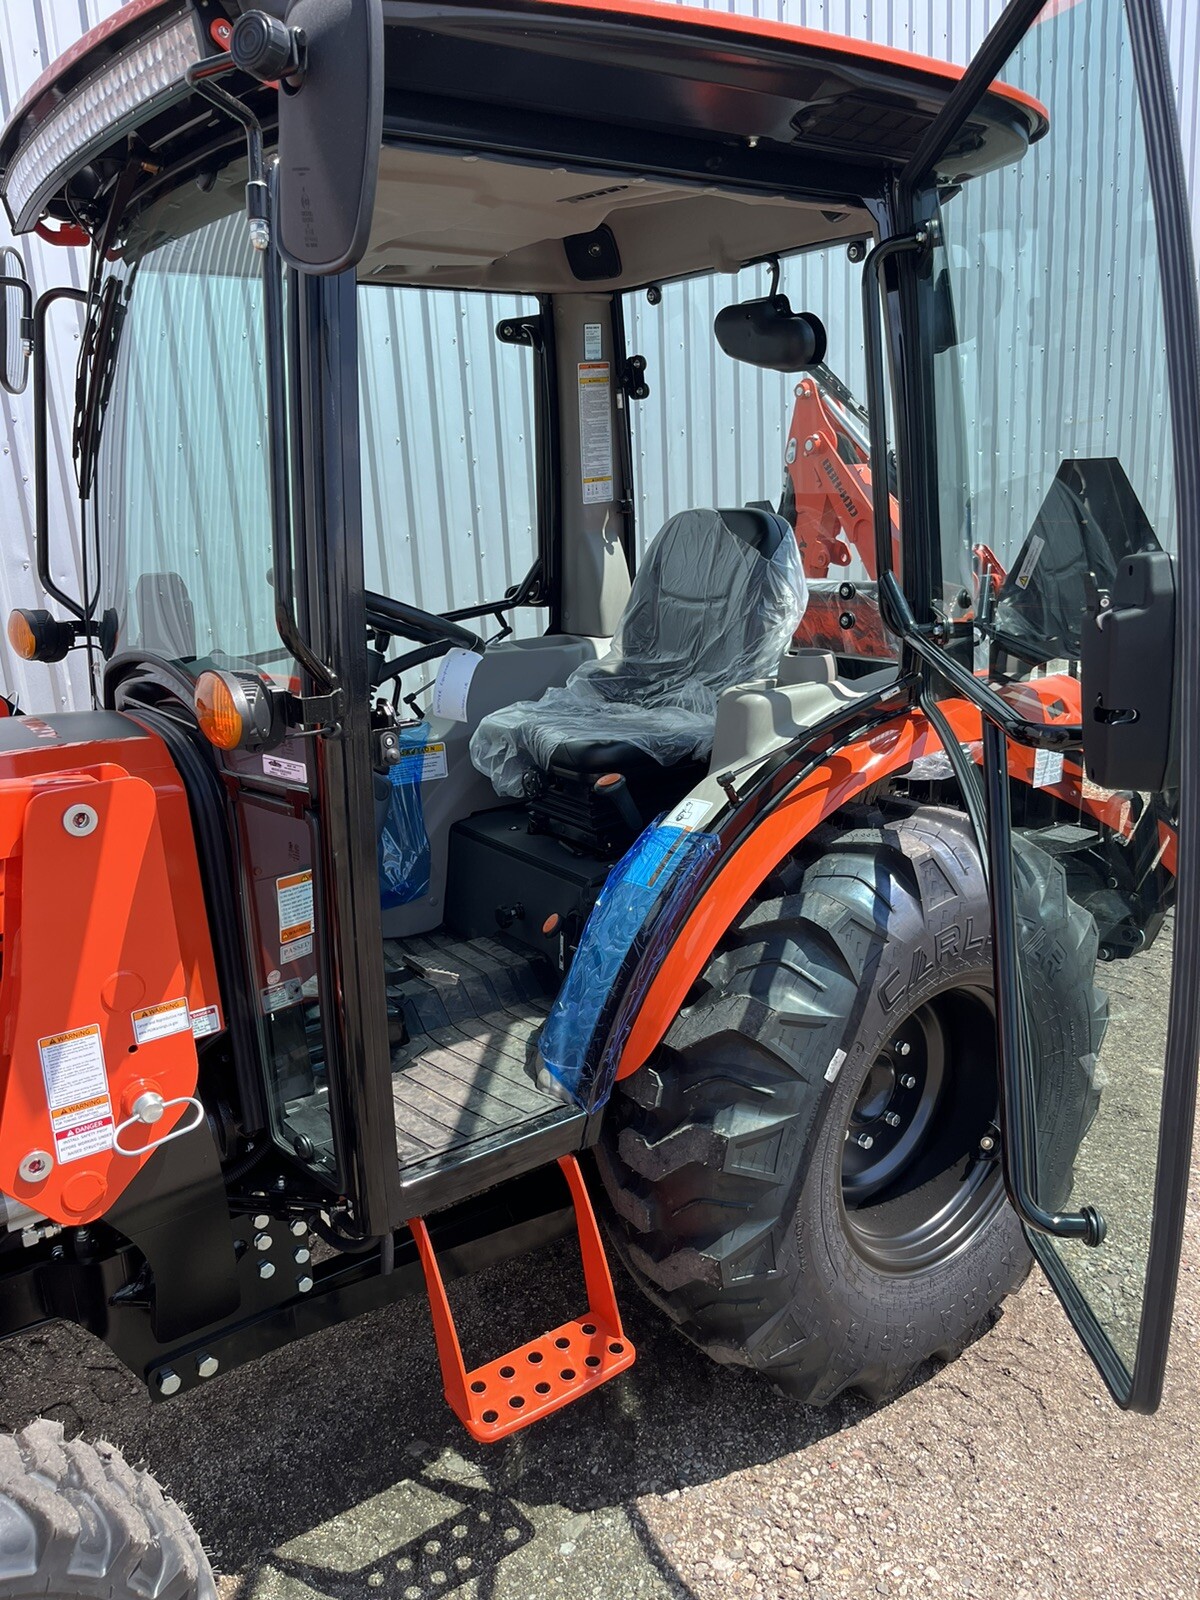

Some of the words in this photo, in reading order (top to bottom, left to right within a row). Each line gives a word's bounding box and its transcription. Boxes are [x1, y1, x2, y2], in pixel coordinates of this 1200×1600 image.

[283, 941, 310, 956] PASSED
[148, 1001, 180, 1015] WARNING
[56, 1028, 91, 1043] WARNING
[69, 1098, 102, 1112] WARNING
[74, 1120, 104, 1134] DANGER
